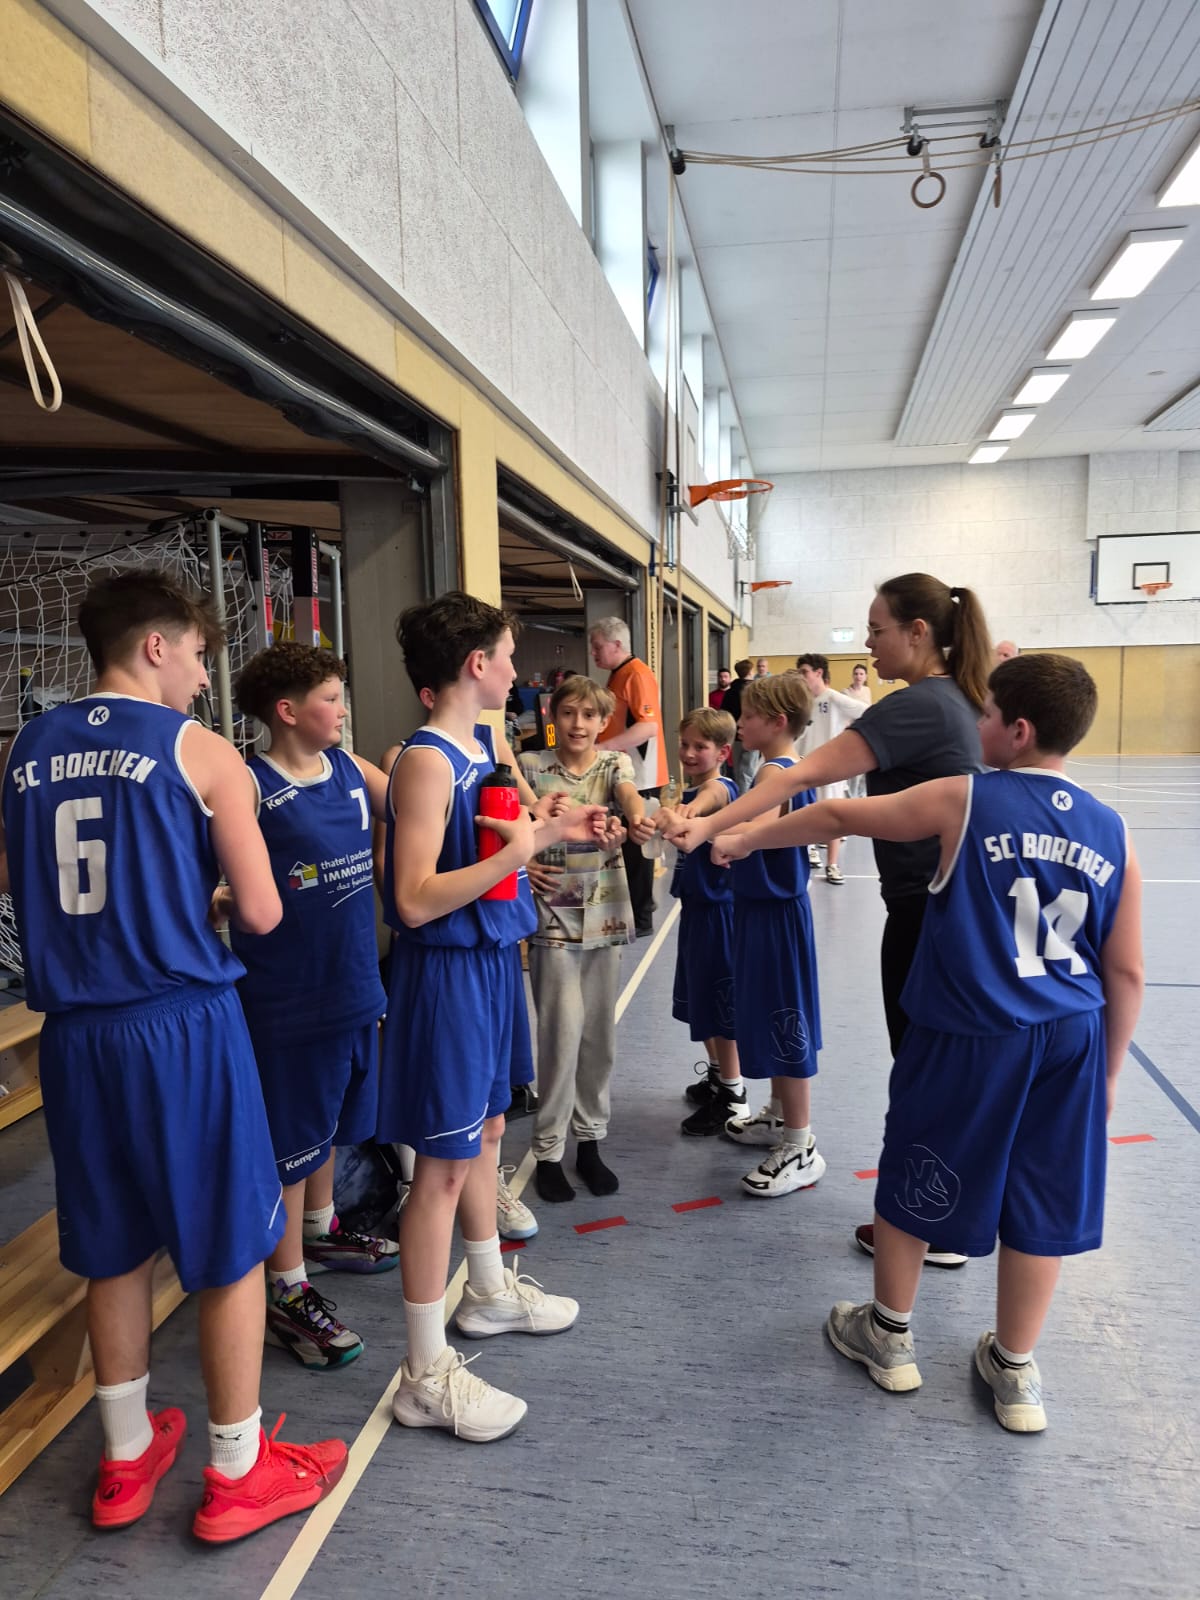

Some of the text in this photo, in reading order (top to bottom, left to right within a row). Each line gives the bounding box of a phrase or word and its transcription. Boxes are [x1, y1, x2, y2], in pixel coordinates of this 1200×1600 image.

[818, 702, 829, 713] 15
[12, 750, 157, 793] SC BORCHEN
[266, 788, 299, 810] Kempa
[349, 787, 369, 831] 7
[55, 796, 107, 915] 6
[984, 832, 1116, 887] SC BORCHEN
[1007, 877, 1089, 978] 14
[285, 1148, 321, 1171] Kempa
